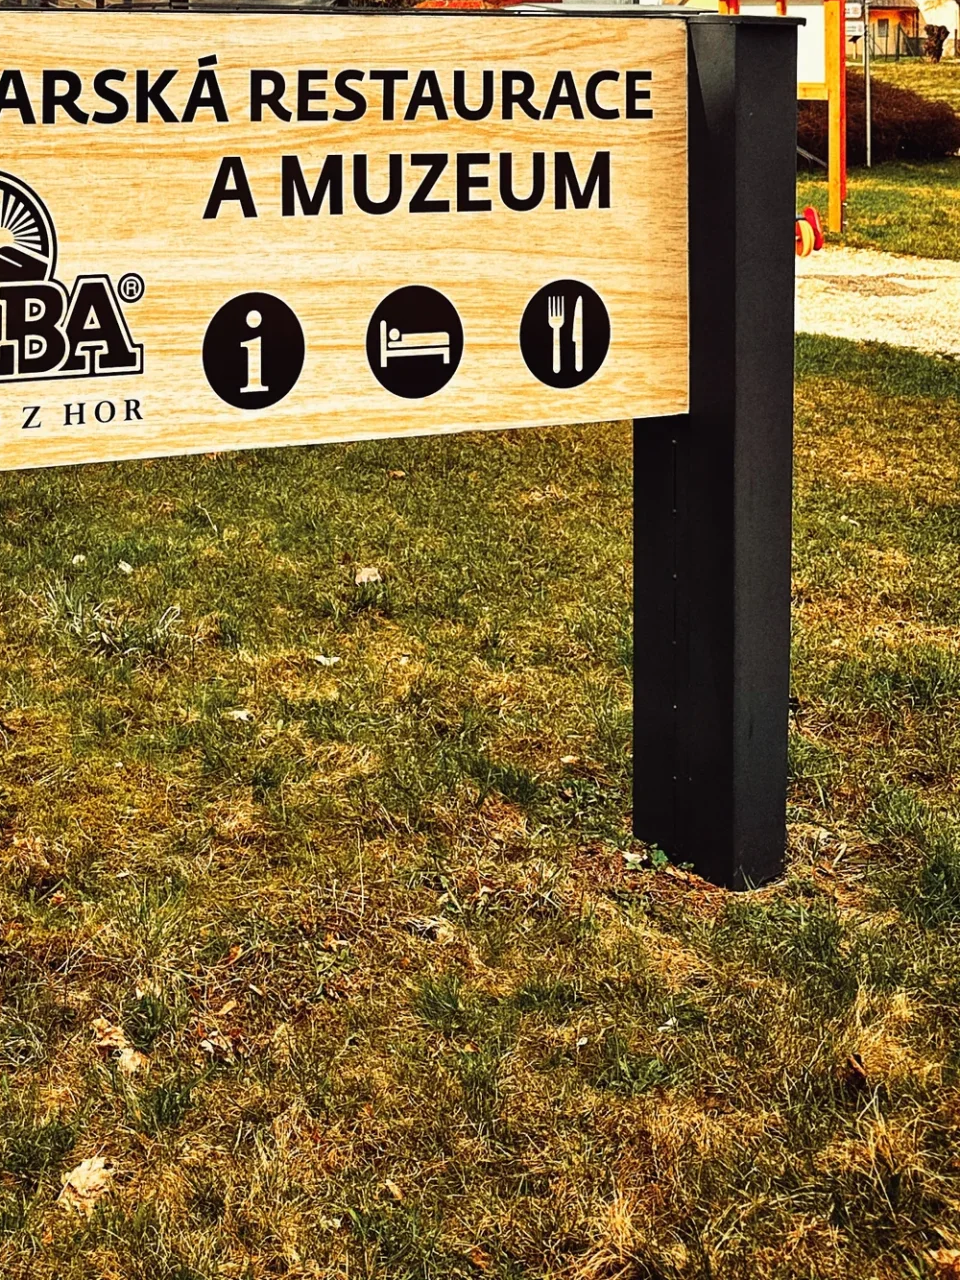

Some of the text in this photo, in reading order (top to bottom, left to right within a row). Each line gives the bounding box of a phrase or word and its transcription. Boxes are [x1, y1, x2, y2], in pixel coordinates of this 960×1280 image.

[249, 68, 654, 122] RESTAURACE
[202, 151, 611, 220] A MUZEUM
[22, 406, 42, 430] Z
[63, 398, 144, 426] HOR
